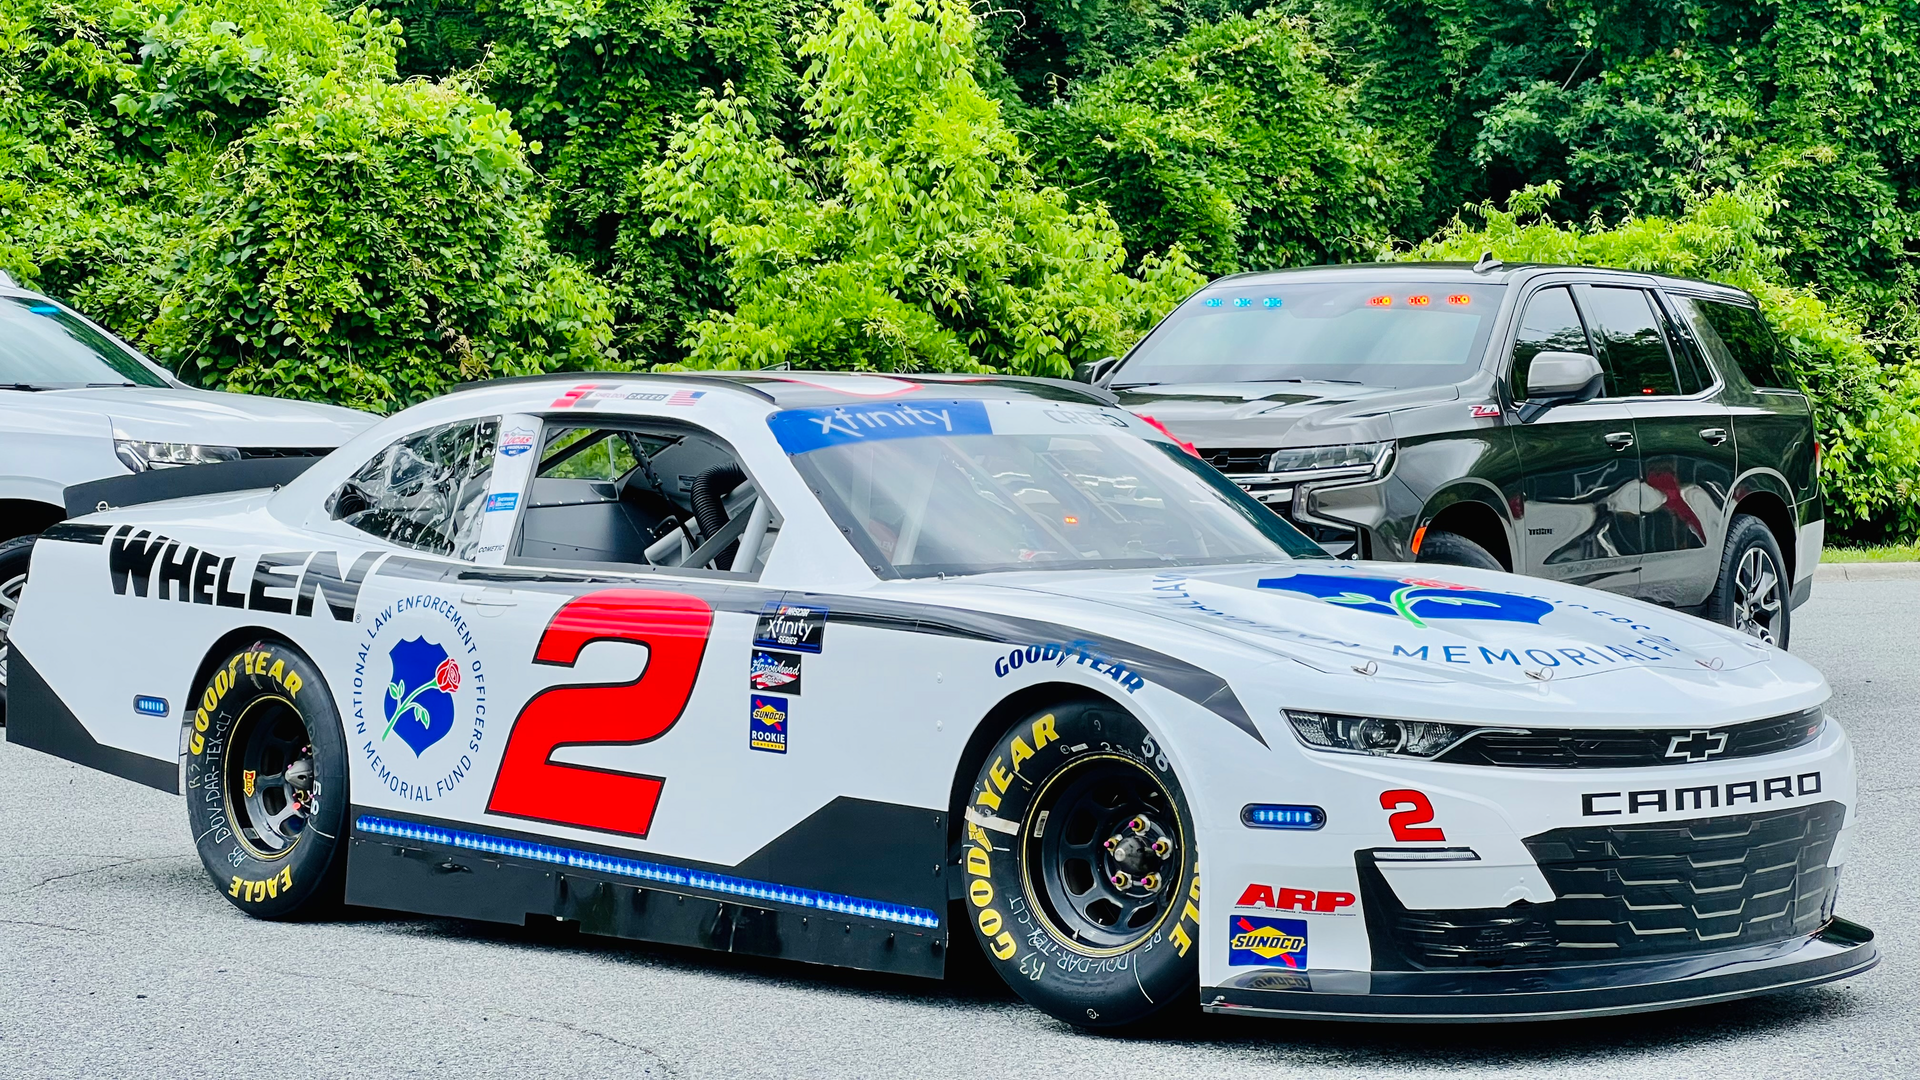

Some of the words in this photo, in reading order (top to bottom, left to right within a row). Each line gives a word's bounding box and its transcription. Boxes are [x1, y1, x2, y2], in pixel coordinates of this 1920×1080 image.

[628, 393, 664, 401] CREED
[808, 405, 953, 437] xfinity
[503, 434, 532, 445] LUCAS
[109, 524, 387, 623] WHELEN
[787, 607, 810, 618] NASCAR
[767, 616, 813, 642] xfinity
[778, 635, 798, 645] SERIES
[751, 659, 800, 676] Arrowhead
[995, 639, 1144, 694] GOODYEAR
[1392, 644, 1661, 668] MEMORIAL
[353, 642, 370, 735] NATIONAL
[367, 605, 392, 639] LAW
[397, 595, 477, 654] ENFORCEMENT
[469, 660, 486, 752] OFFICERS
[190, 651, 303, 756] GOODYEAR
[484, 588, 715, 840] 2
[754, 710, 784, 720] SUNOCO
[752, 730, 785, 743] ROOKIE
[188, 764, 200, 790] R3
[363, 740, 433, 802] MEMORIAL
[437, 755, 472, 798] FUND
[1581, 771, 1822, 816] CAMARO
[1379, 788, 1446, 842] 2
[966, 713, 1060, 961] GOODYEAR
[229, 864, 293, 903] EAGLE
[1236, 883, 1356, 912] ARP
[1144, 928, 1162, 952] RF
[1234, 935, 1302, 950] SUNOCO
[1019, 951, 1045, 981] R3
